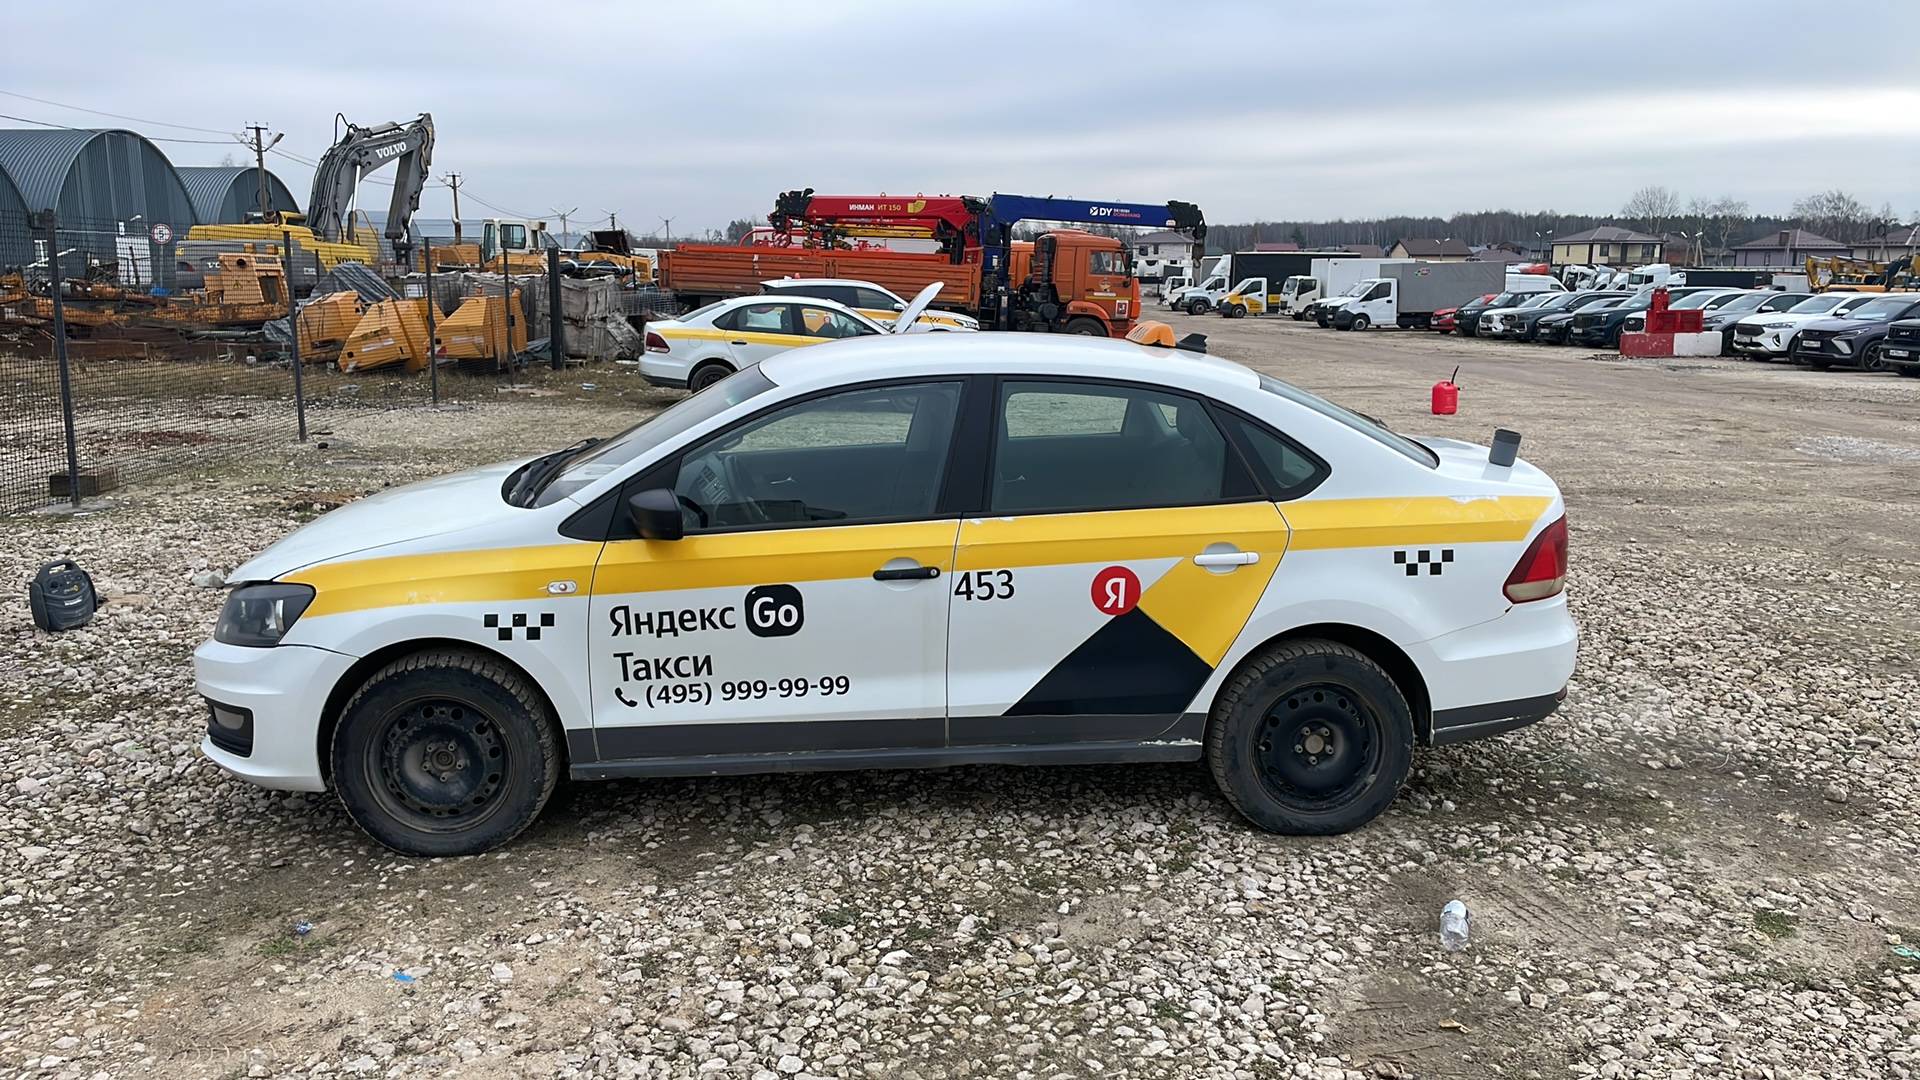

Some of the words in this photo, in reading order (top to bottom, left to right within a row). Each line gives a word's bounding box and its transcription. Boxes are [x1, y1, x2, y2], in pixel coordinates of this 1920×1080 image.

[375, 141, 407, 159] VOLVO
[1099, 207, 1112, 216] DY
[158, 228, 165, 239] 5
[953, 569, 1015, 601] 453
[1103, 577, 1126, 609] Я
[609, 605, 736, 638] Яндекс
[752, 596, 799, 628] Go
[613, 651, 713, 682] Такси
[645, 682, 713, 708] (495)
[720, 675, 850, 701] 999-99-99
